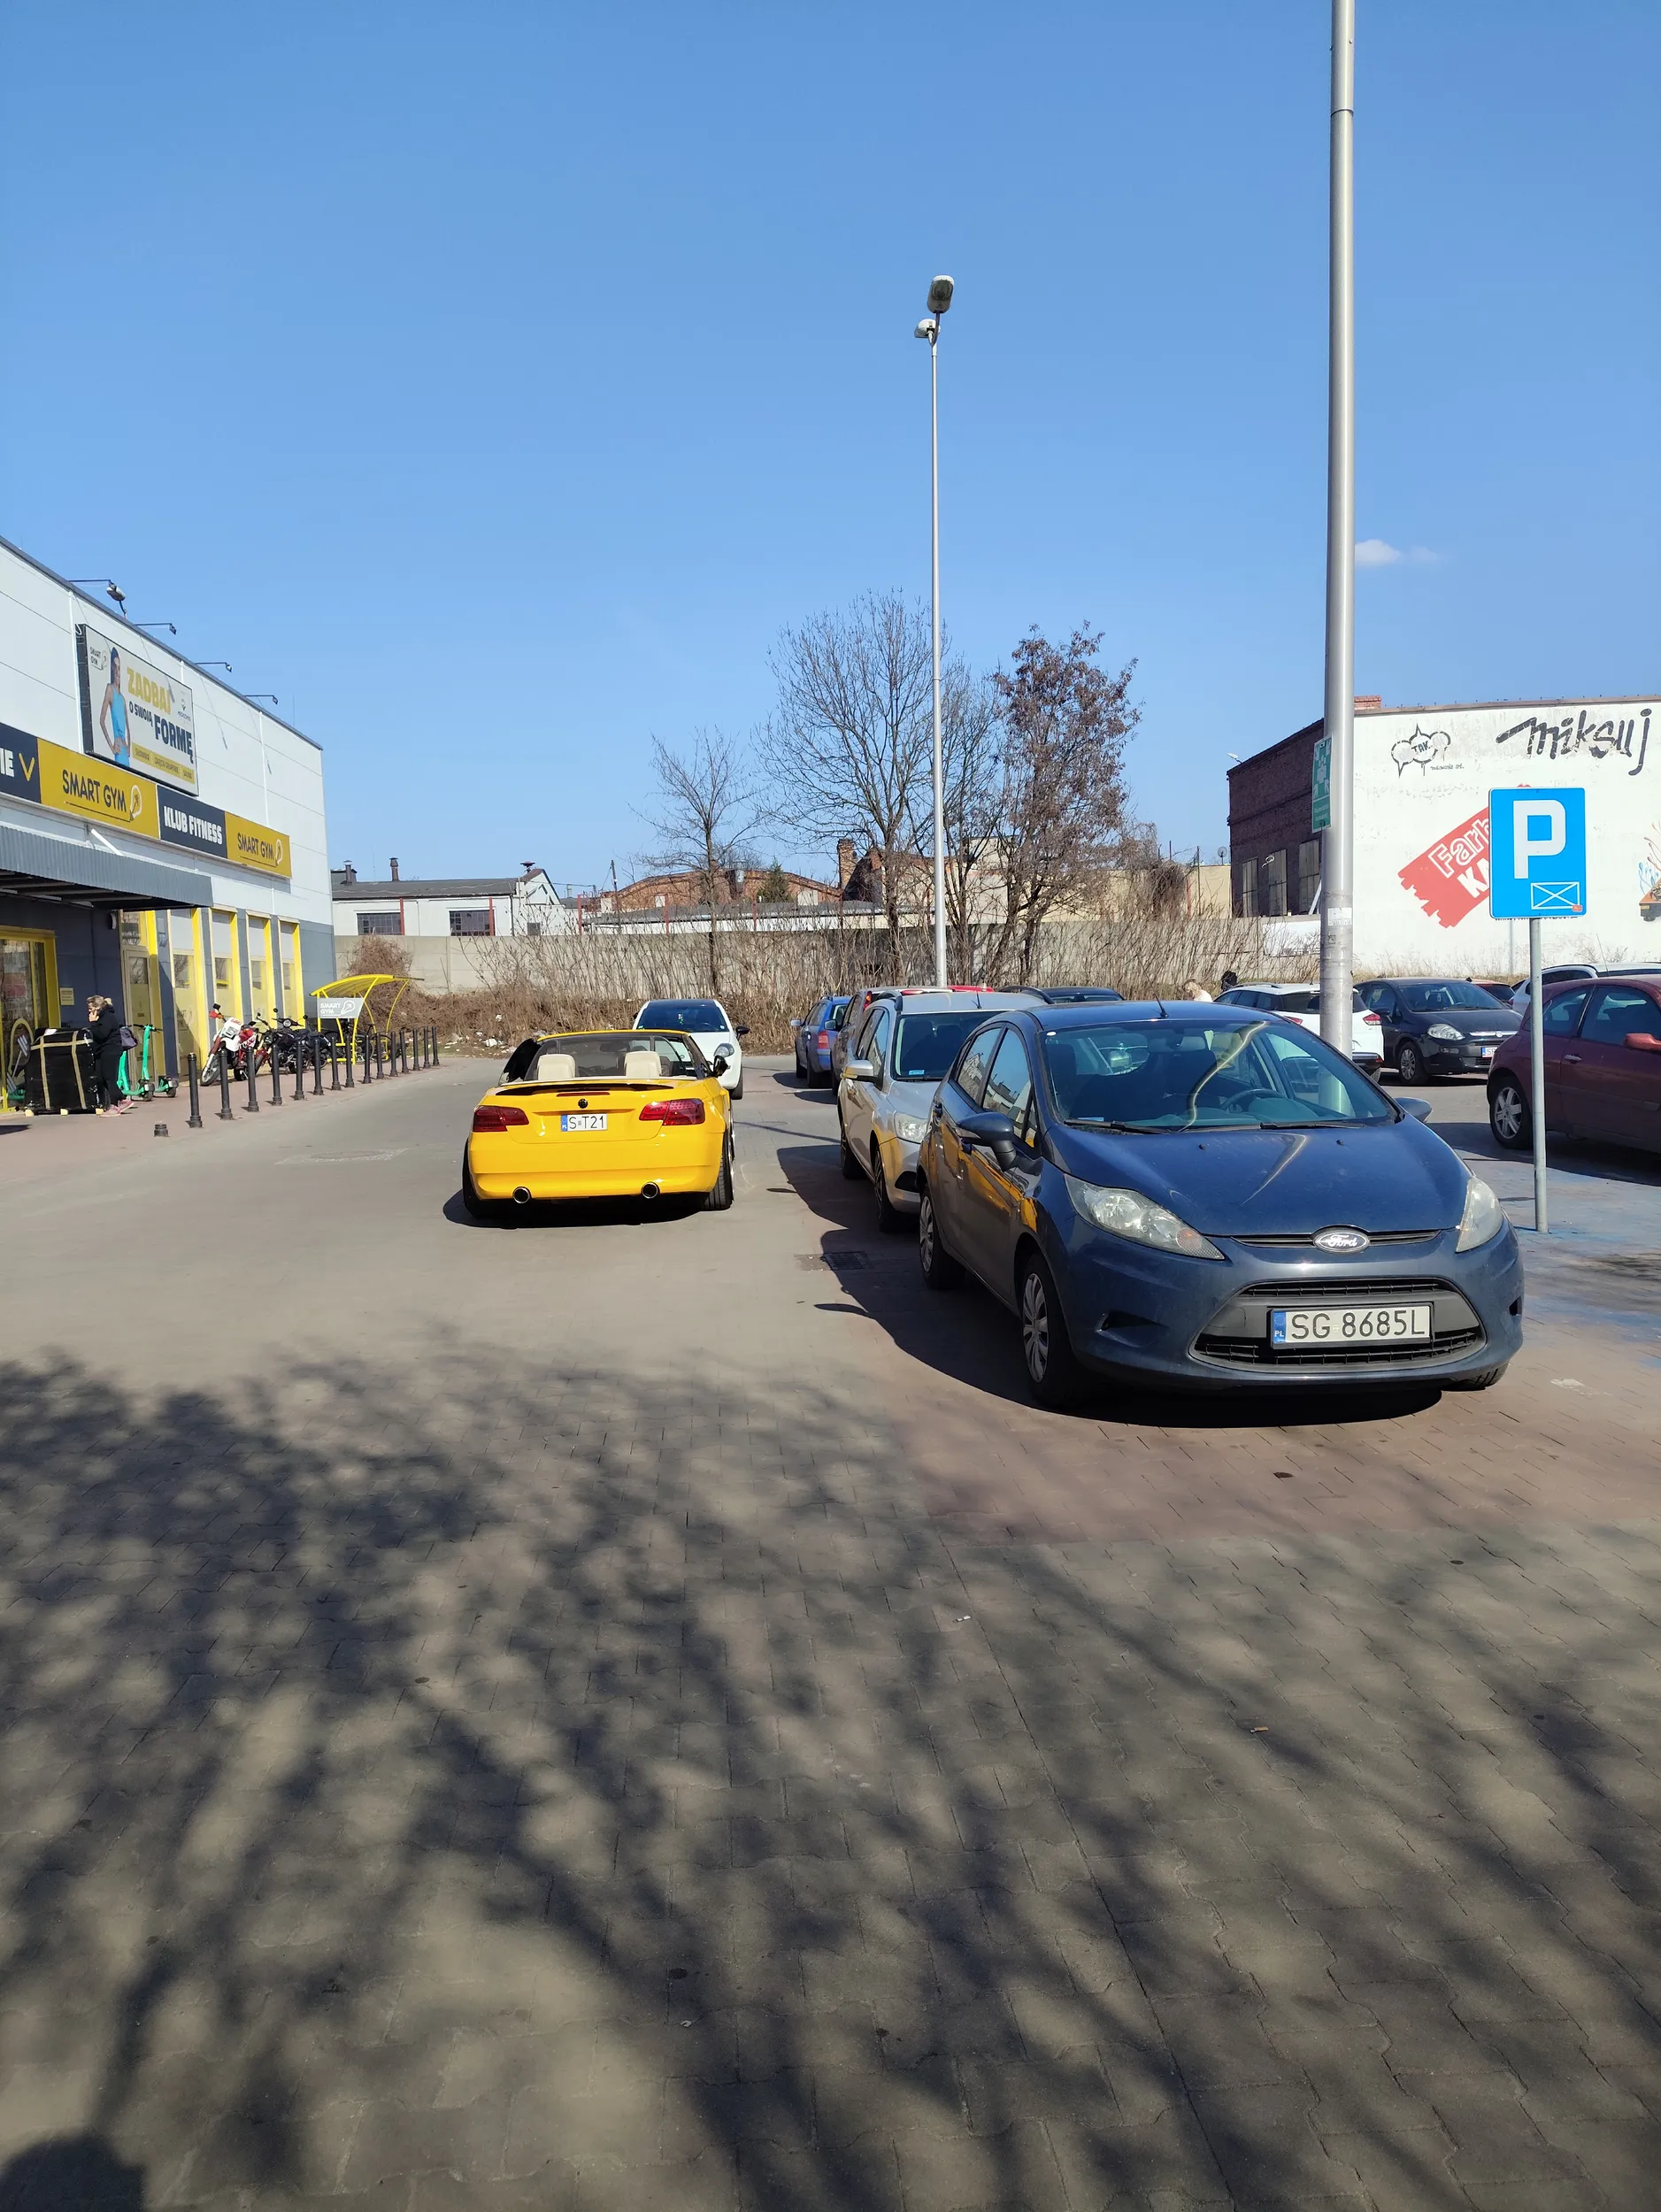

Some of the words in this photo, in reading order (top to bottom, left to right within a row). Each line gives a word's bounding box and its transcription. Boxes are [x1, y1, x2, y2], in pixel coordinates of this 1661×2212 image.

[127, 666, 172, 715] ZADBAJ
[128, 700, 134, 714] O
[153, 713, 194, 764] FORMĘ
[1496, 709, 1653, 776] miksuj
[62, 769, 101, 803] SMART
[103, 784, 127, 813] GYM
[164, 805, 188, 833] KLUB
[188, 814, 223, 845] FITNESS
[1513, 800, 1566, 879] P
[237, 833, 259, 856] SMART
[260, 840, 274, 861] GYM
[568, 1117, 577, 1129] S
[581, 1116, 604, 1129] T21
[1327, 1233, 1358, 1248] Ford
[1291, 1312, 1331, 1340] SG
[1342, 1310, 1426, 1338] 8685L
